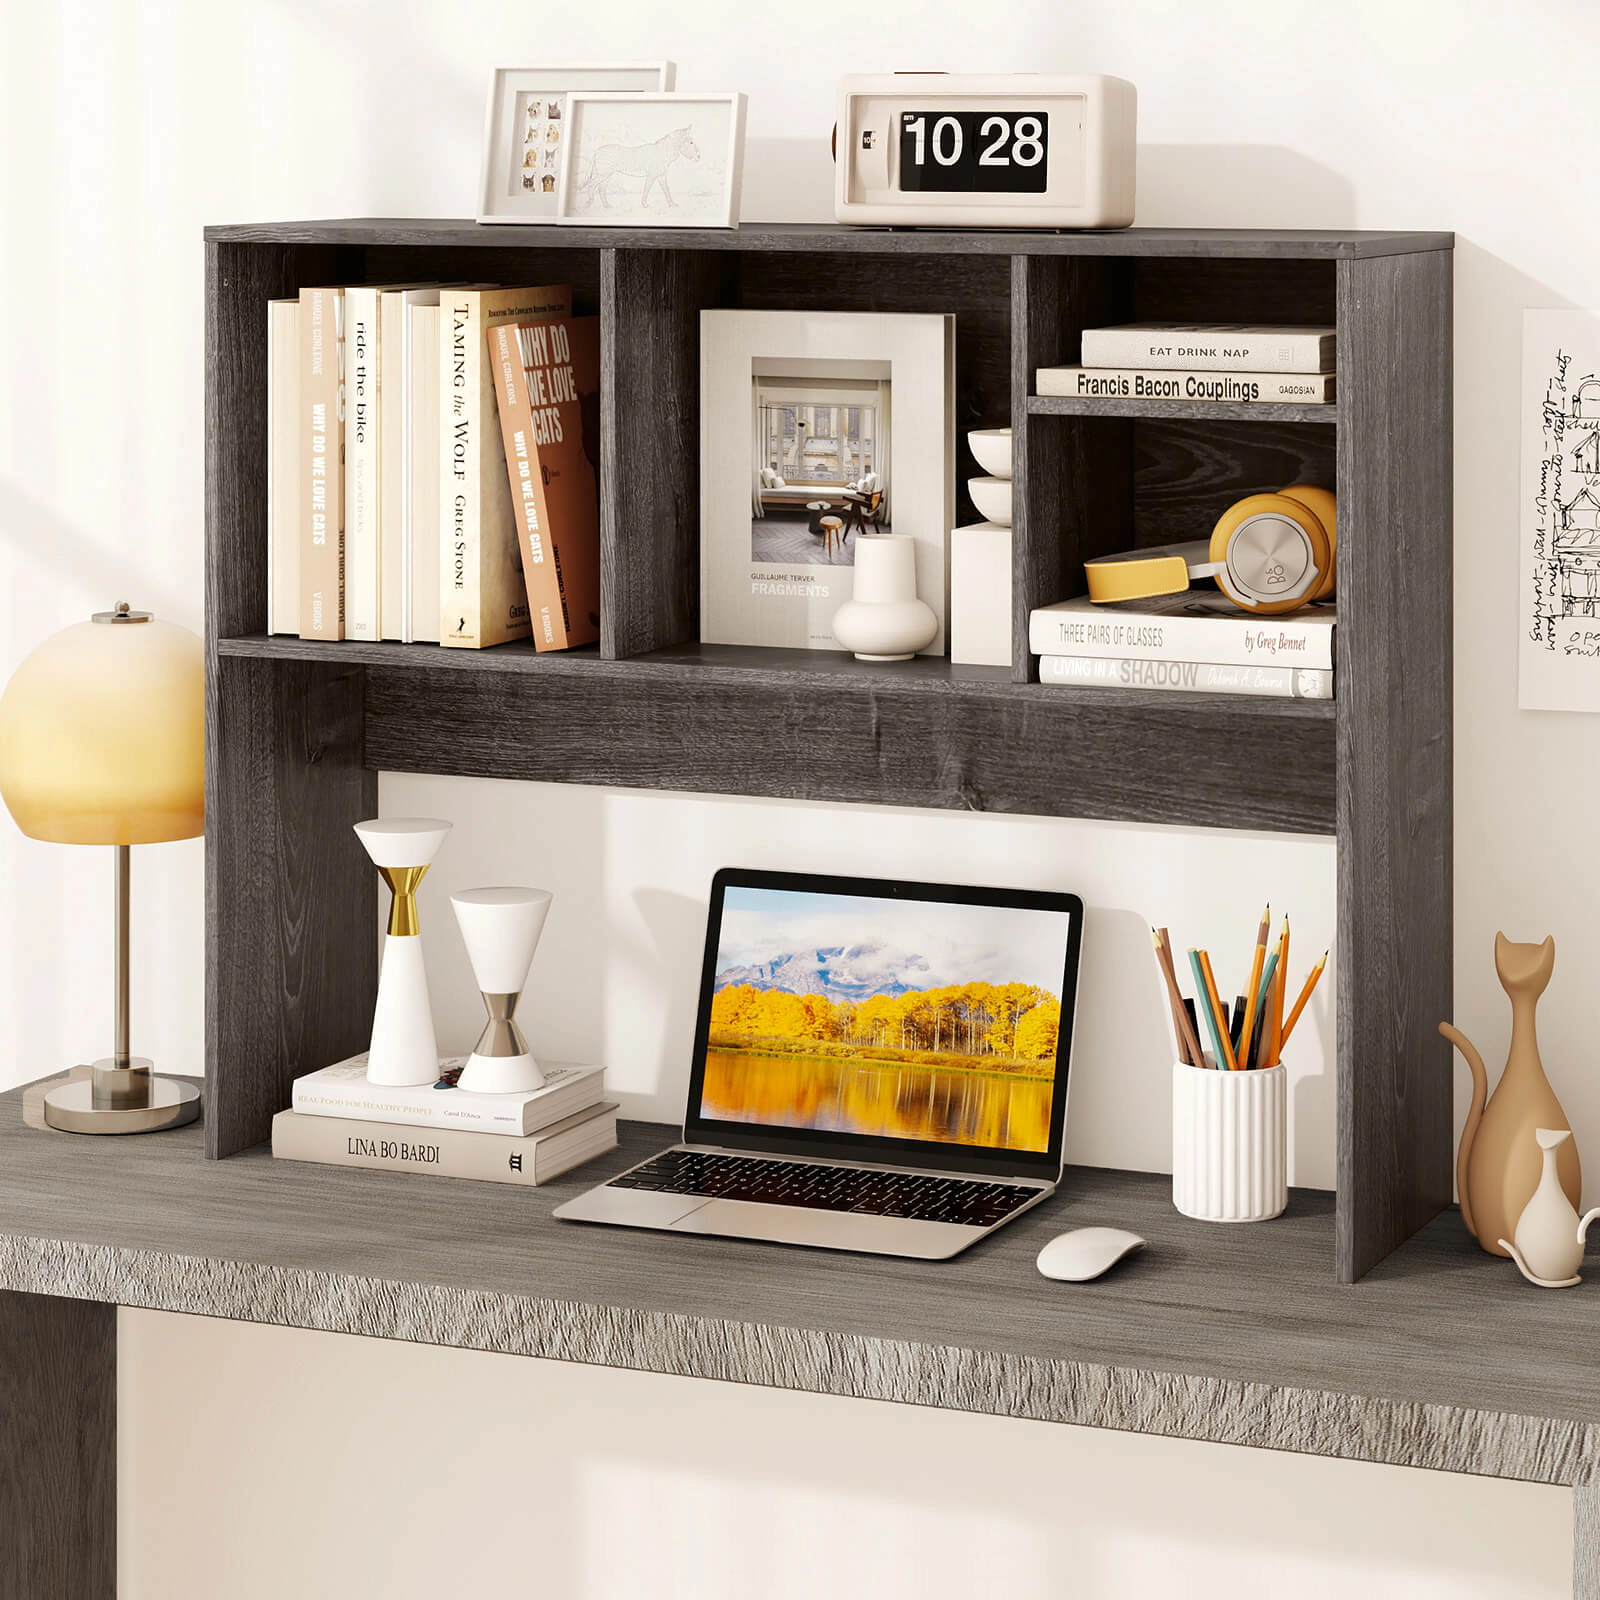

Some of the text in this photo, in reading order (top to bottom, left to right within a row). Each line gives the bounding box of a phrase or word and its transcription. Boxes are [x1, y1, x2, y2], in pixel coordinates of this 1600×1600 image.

[905, 116, 1044, 167] 10 28
[514, 324, 571, 367] WHY DO
[1149, 347, 1250, 358] EAT DRINK NAP
[356, 322, 367, 444] ride the bike
[523, 366, 578, 407] WE LOVE
[1077, 373, 1260, 402] Francis Bacon Couplings
[1278, 385, 1316, 395] GAGOSIAN
[452, 394, 467, 418] the
[531, 407, 563, 446] CATS
[312, 402, 326, 545] WHY DO WE LOVE CATS
[513, 430, 544, 564] WHY DO WE LOVE CATS
[750, 572, 815, 582] GUILLAUME TERVER
[750, 582, 831, 598] FRAGMENTS
[1059, 623, 1164, 648] THREE PAIRS OF GLASSES
[1245, 630, 1307, 653] by Greg Bennet
[1054, 659, 1091, 677] LIVING
[1092, 661, 1107, 678] IN
[1109, 663, 1118, 680] A
[1119, 659, 1199, 687] SHADOW
[347, 1136, 440, 1164] LINA BO BARDI
